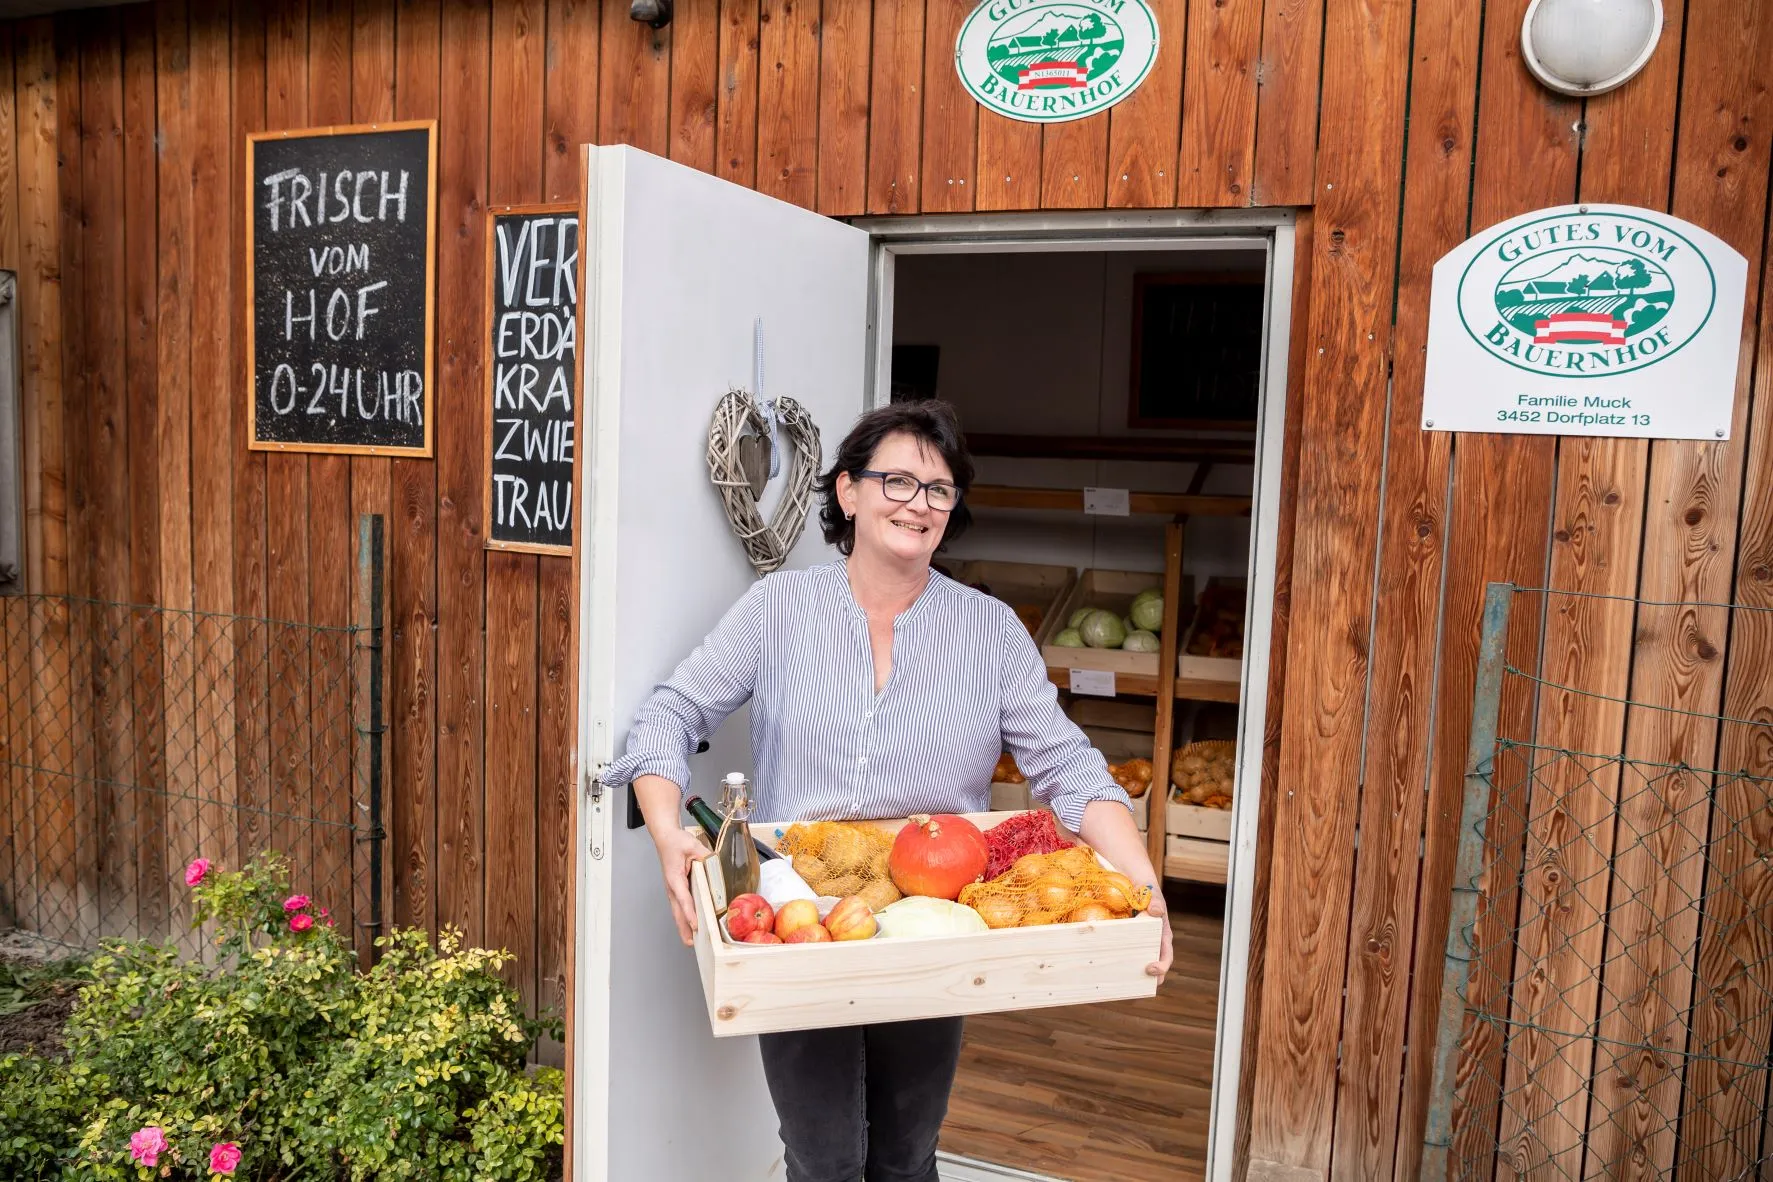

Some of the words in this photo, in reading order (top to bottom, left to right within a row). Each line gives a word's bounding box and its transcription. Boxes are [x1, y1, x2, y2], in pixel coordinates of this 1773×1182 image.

[989, 0, 1036, 21] GU
[979, 69, 1123, 114] BAUERNHOF
[264, 167, 410, 232] FRISCH
[310, 244, 369, 278] VOM
[1497, 222, 1601, 264] GUTES
[1615, 225, 1680, 263] VOM
[286, 281, 388, 342] HOF
[1483, 320, 1674, 372] BAUERNHOF
[495, 363, 571, 413] KRA
[1518, 394, 1578, 408] Familie
[1584, 396, 1632, 409] Muck
[494, 419, 574, 464] ZWIE
[1497, 411, 1541, 423] 3452
[1546, 411, 1627, 427] Dorfplatz
[1631, 414, 1651, 427] 13
[493, 474, 572, 531] TRAU
